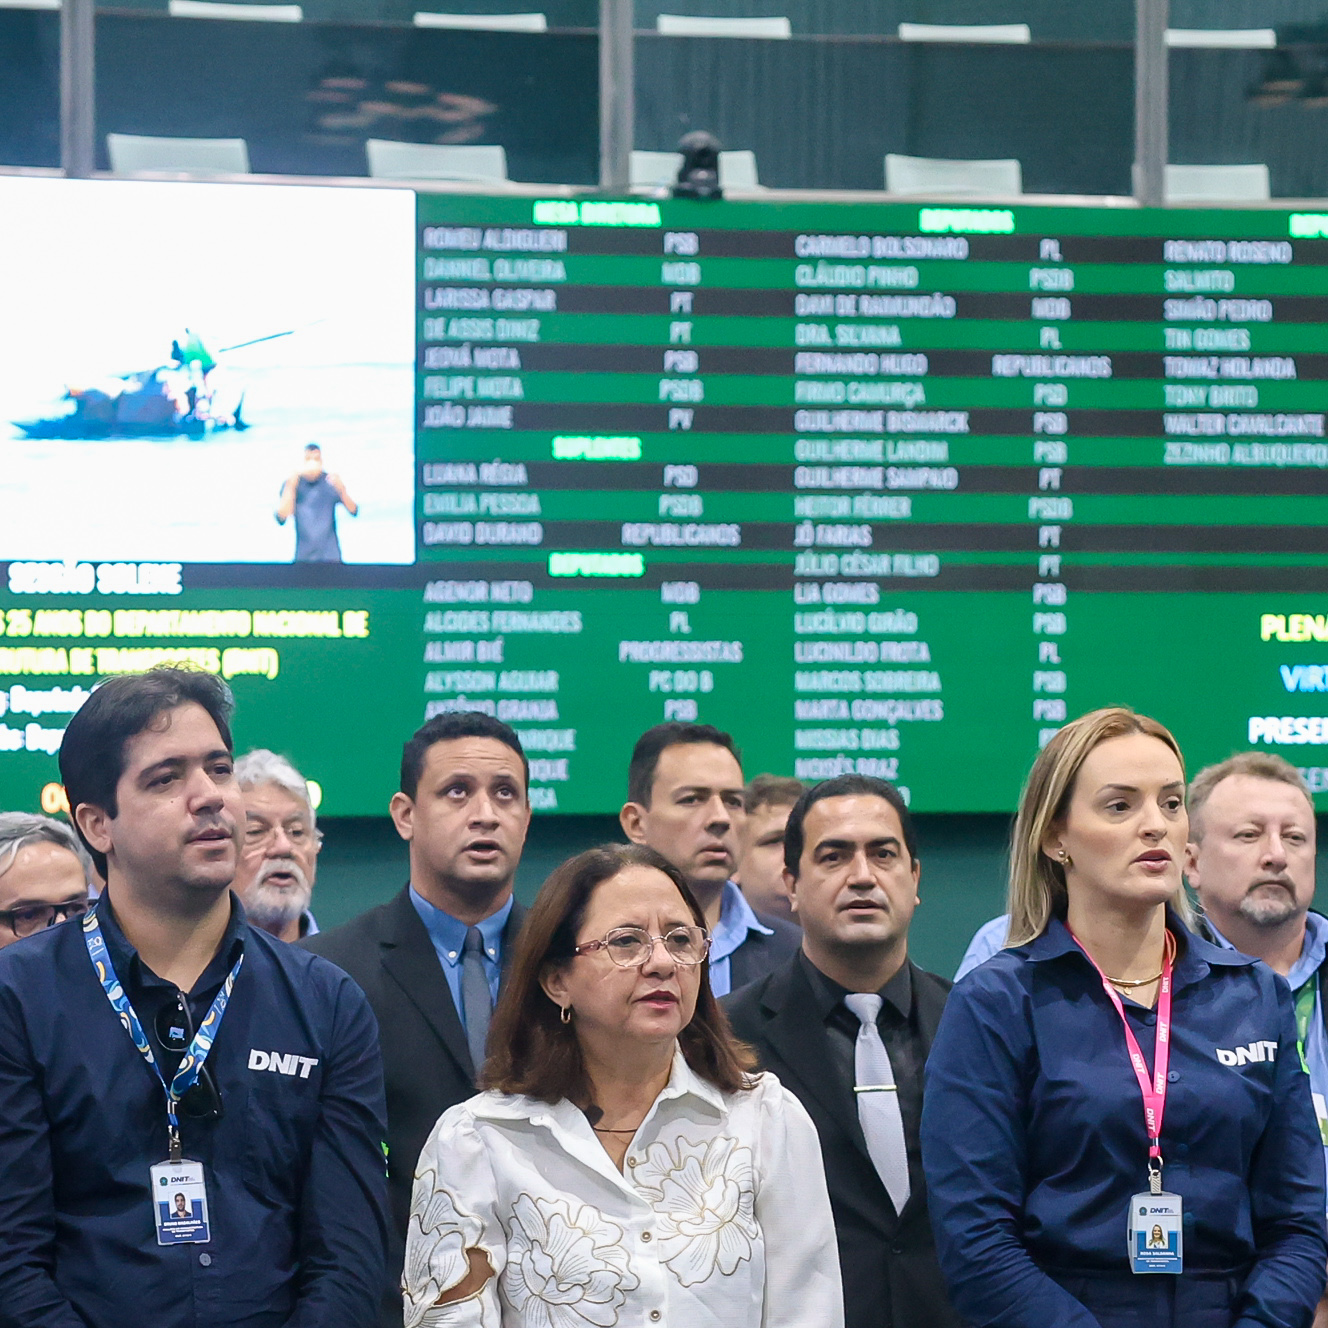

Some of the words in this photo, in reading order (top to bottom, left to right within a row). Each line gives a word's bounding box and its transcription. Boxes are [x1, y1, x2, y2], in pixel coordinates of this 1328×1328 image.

[1159, 1022, 1168, 1042] DNIT
[248, 1049, 319, 1079] DNIT
[1132, 1053, 1146, 1075] DNIT
[1216, 1039, 1277, 1066] DNIT
[1156, 1072, 1165, 1094] DNIT
[1146, 1108, 1156, 1132] DNIT
